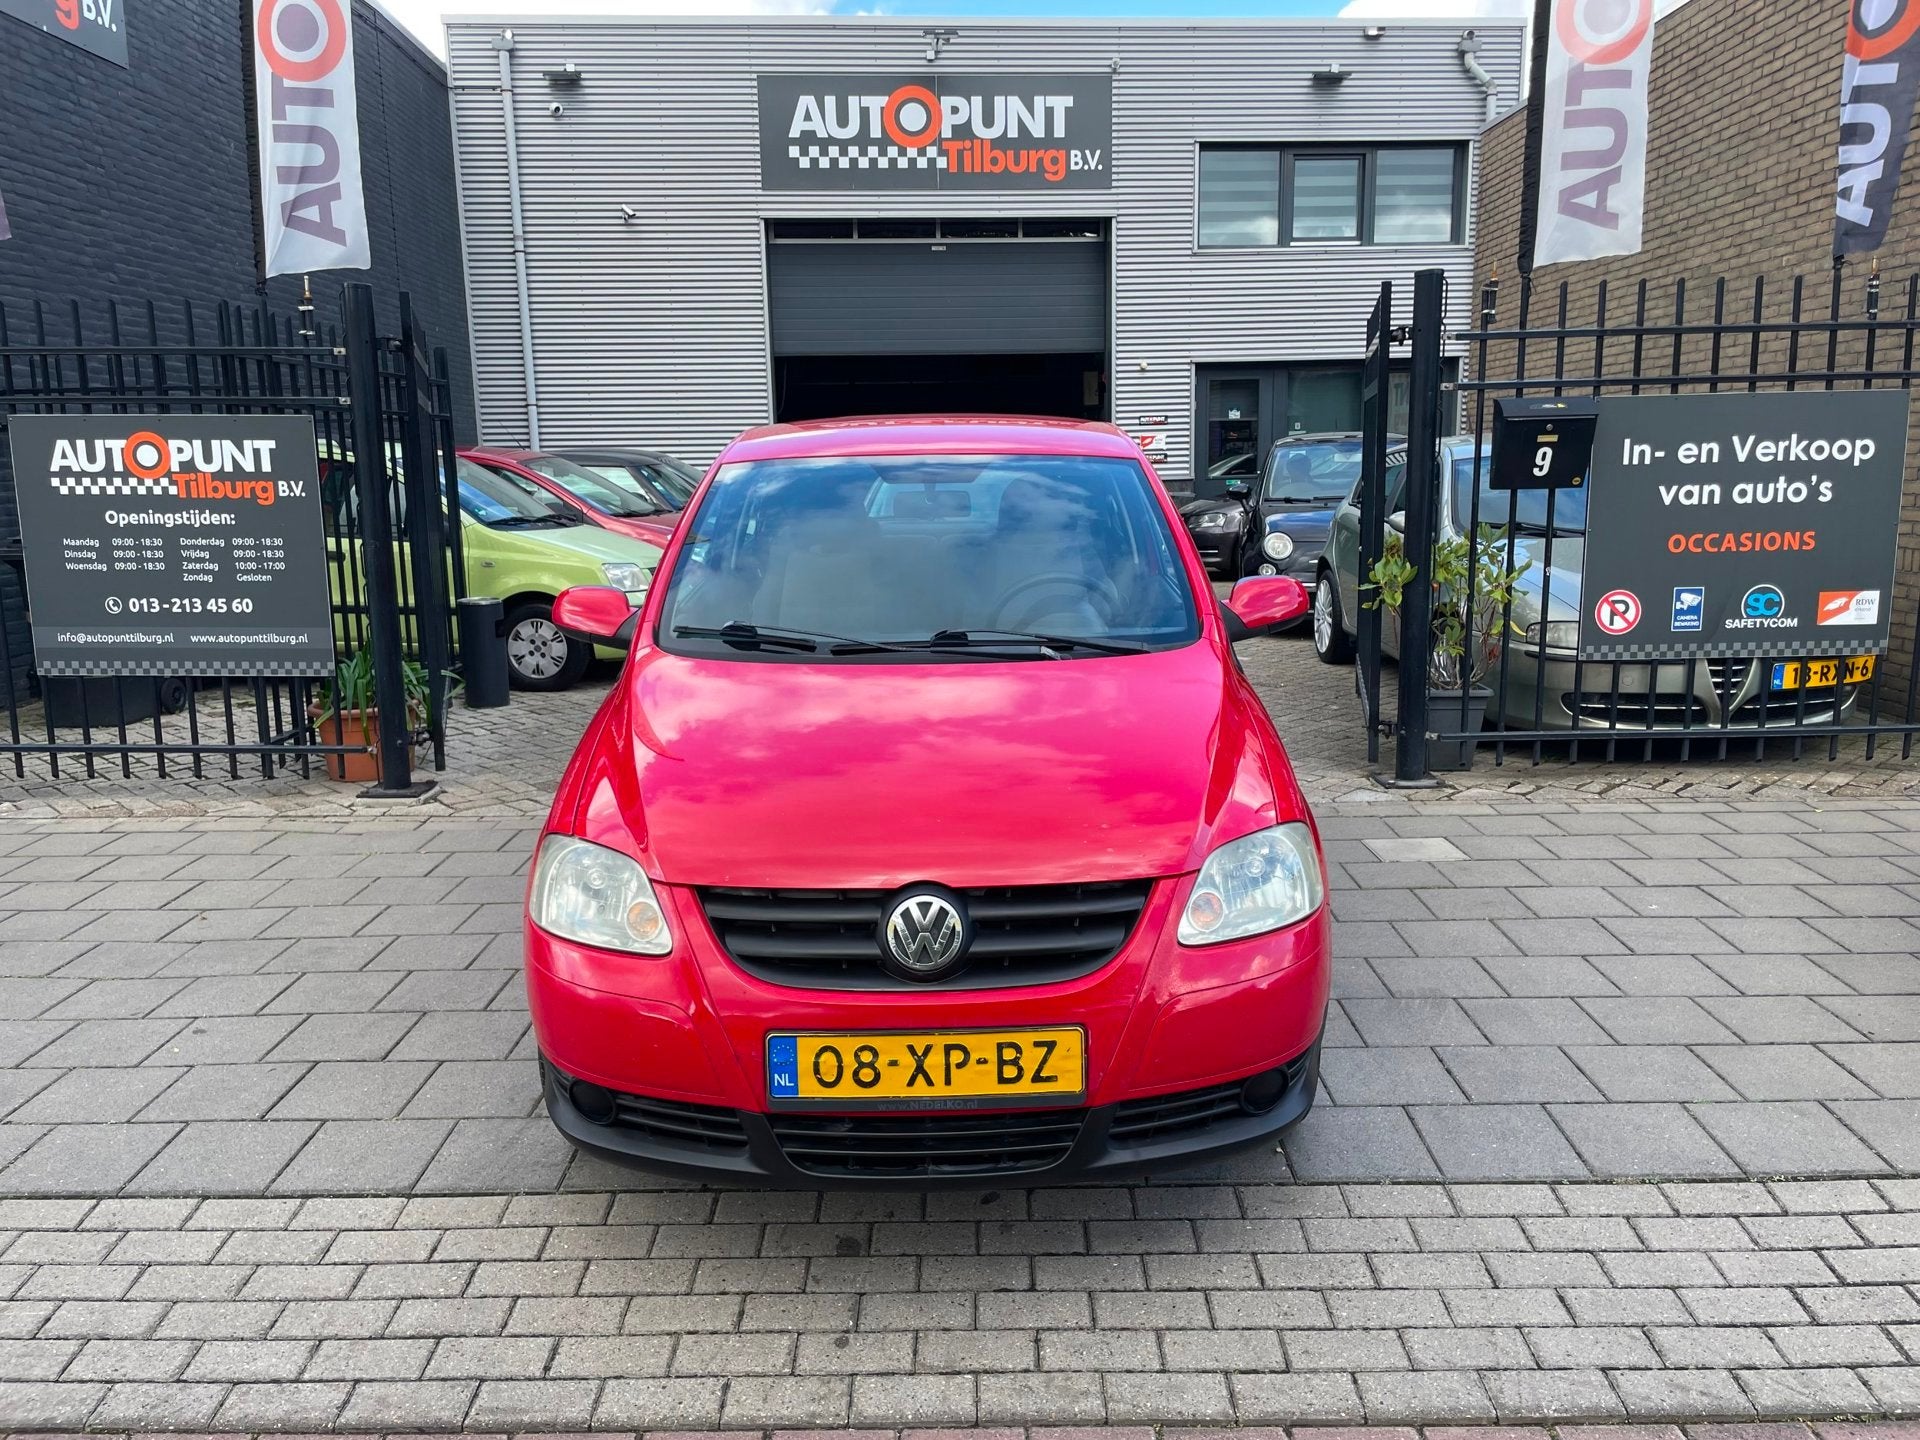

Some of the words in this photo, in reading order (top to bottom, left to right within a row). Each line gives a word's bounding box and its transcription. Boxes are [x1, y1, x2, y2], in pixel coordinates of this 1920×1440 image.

[788, 84, 1074, 148] AUTOPUNT
[942, 138, 1066, 181] Tilburg
[1070, 149, 1104, 171] B.V.
[50, 431, 276, 480] AUTOPUNT
[1621, 437, 1666, 466] In-
[1677, 438, 1720, 465] en
[1731, 433, 1877, 467] Verkoop
[1532, 446, 1553, 477] 9
[172, 473, 276, 506] Tilburg
[278, 480, 306, 498] B.V.
[1658, 484, 1721, 507] van
[1732, 475, 1834, 505] auto's
[104, 508, 236, 528] Openingstijden:
[63, 538, 100, 548] Maandag
[111, 538, 134, 546] 09:00
[140, 538, 163, 546] 18:30
[180, 537, 225, 547] Donderdag
[232, 538, 255, 546] 09:00
[261, 538, 284, 546] 18:30
[1667, 530, 1817, 554] OCCASIONS
[64, 550, 97, 560] Dinsdag
[113, 550, 136, 559] 09:00
[142, 550, 165, 559] 18:30
[180, 549, 210, 559] Vrijdag
[233, 550, 256, 558] 09:00
[262, 550, 285, 558] 18:30
[65, 562, 107, 572] Woensdag
[114, 562, 137, 571] 09:00
[143, 562, 166, 571] 18:30
[182, 561, 219, 571] Zaterdag
[234, 562, 258, 570] 10:00
[264, 562, 286, 570] 17:00
[183, 573, 213, 583] Zondag
[236, 573, 273, 582] Gesloten
[206, 597, 228, 614] 45
[231, 597, 254, 614] 60
[1855, 598, 1876, 606] RDW
[1724, 617, 1799, 629] SAFETYCOM
[57, 632, 175, 646] info@autopunttilburg.nl
[190, 632, 309, 646] www.autopunttilburg.nl
[812, 1039, 1059, 1090] 08-XP-BZ
[774, 1073, 795, 1087] NL
